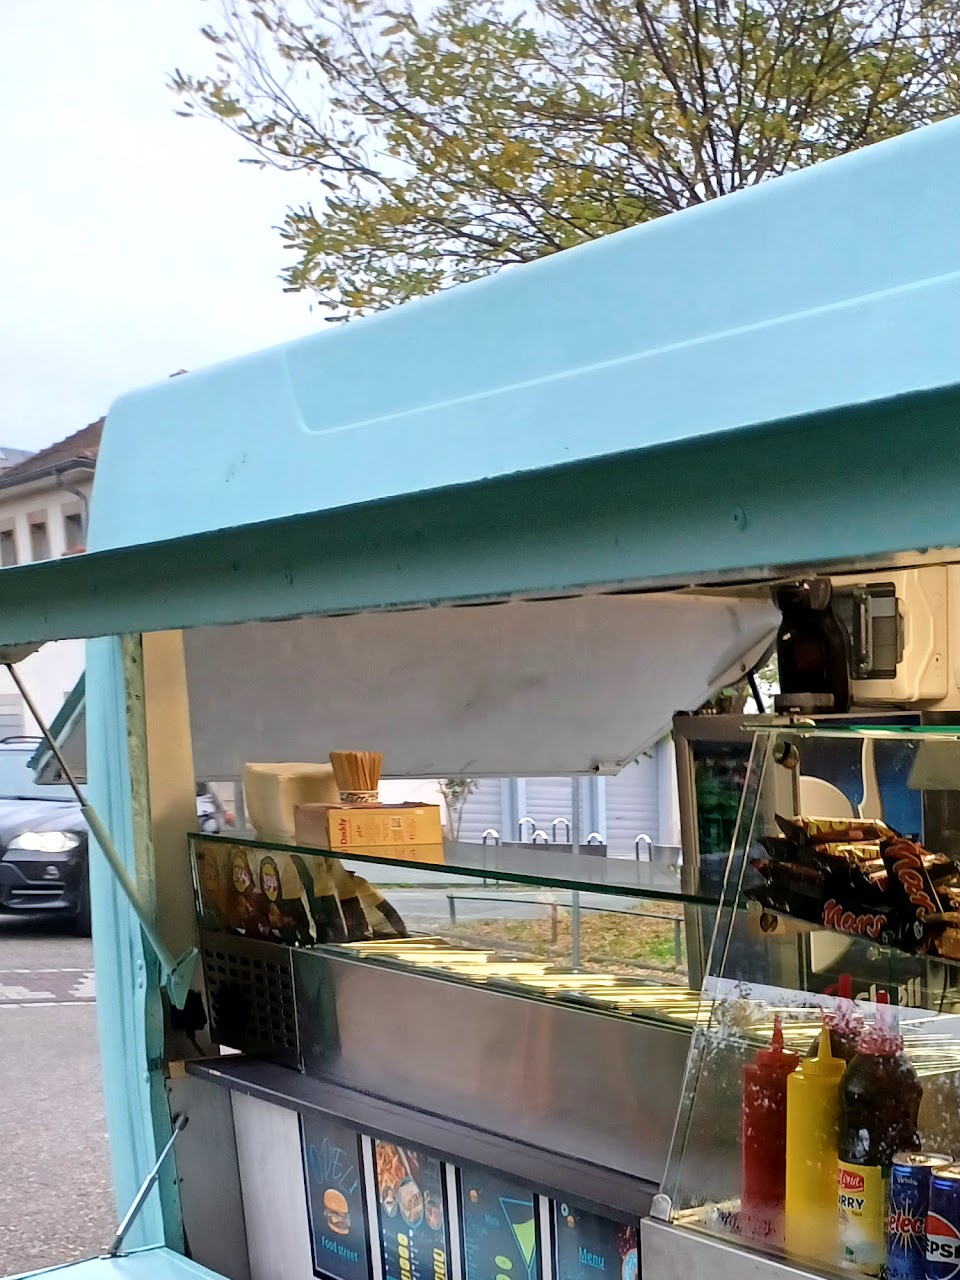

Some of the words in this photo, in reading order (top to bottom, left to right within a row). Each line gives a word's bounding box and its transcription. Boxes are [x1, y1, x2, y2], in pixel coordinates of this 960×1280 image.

[338, 818, 349, 845] Daddy
[822, 898, 888, 938] Mars
[320, 1235, 337, 1253] Food
[338, 1244, 360, 1264] street
[578, 1246, 605, 1269] Menu
